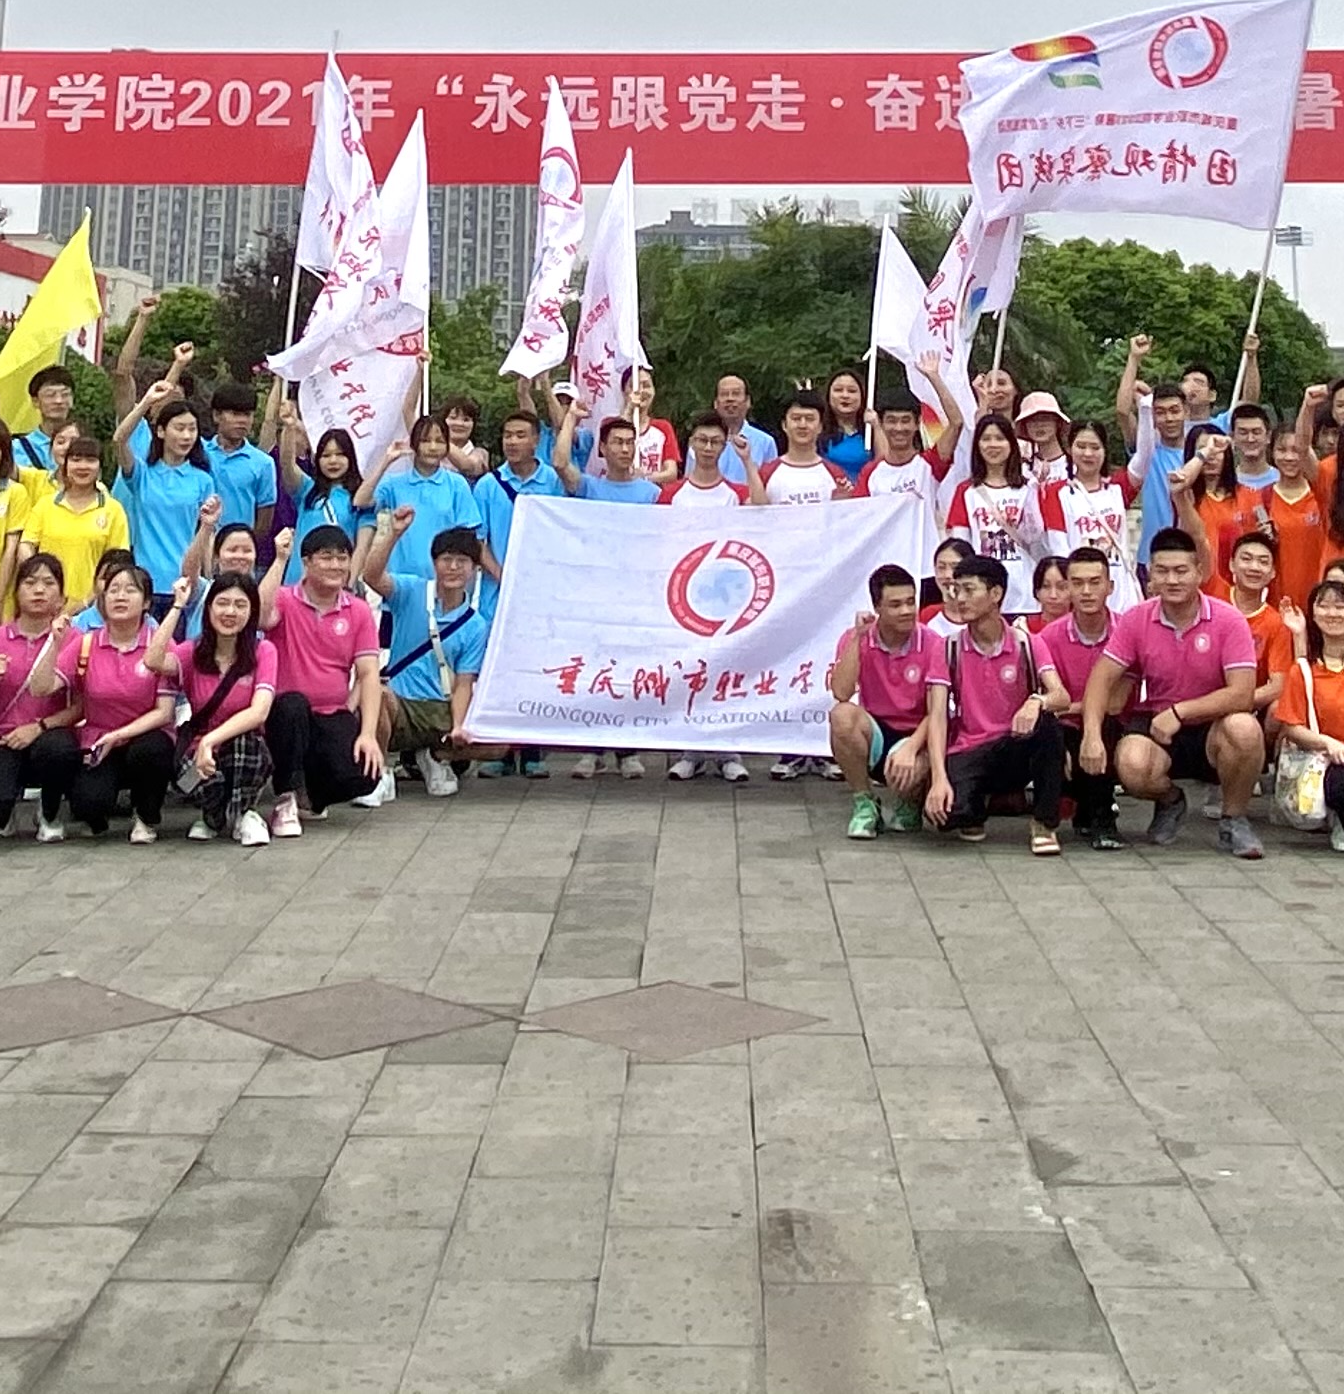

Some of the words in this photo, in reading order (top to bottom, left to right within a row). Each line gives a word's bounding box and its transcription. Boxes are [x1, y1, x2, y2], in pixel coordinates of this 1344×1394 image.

[543, 656, 836, 716] 重庆城市职业学
[518, 700, 624, 727] CHONGQING
[633, 714, 672, 726] CITY
[684, 710, 794, 725] VOCATIONAL
